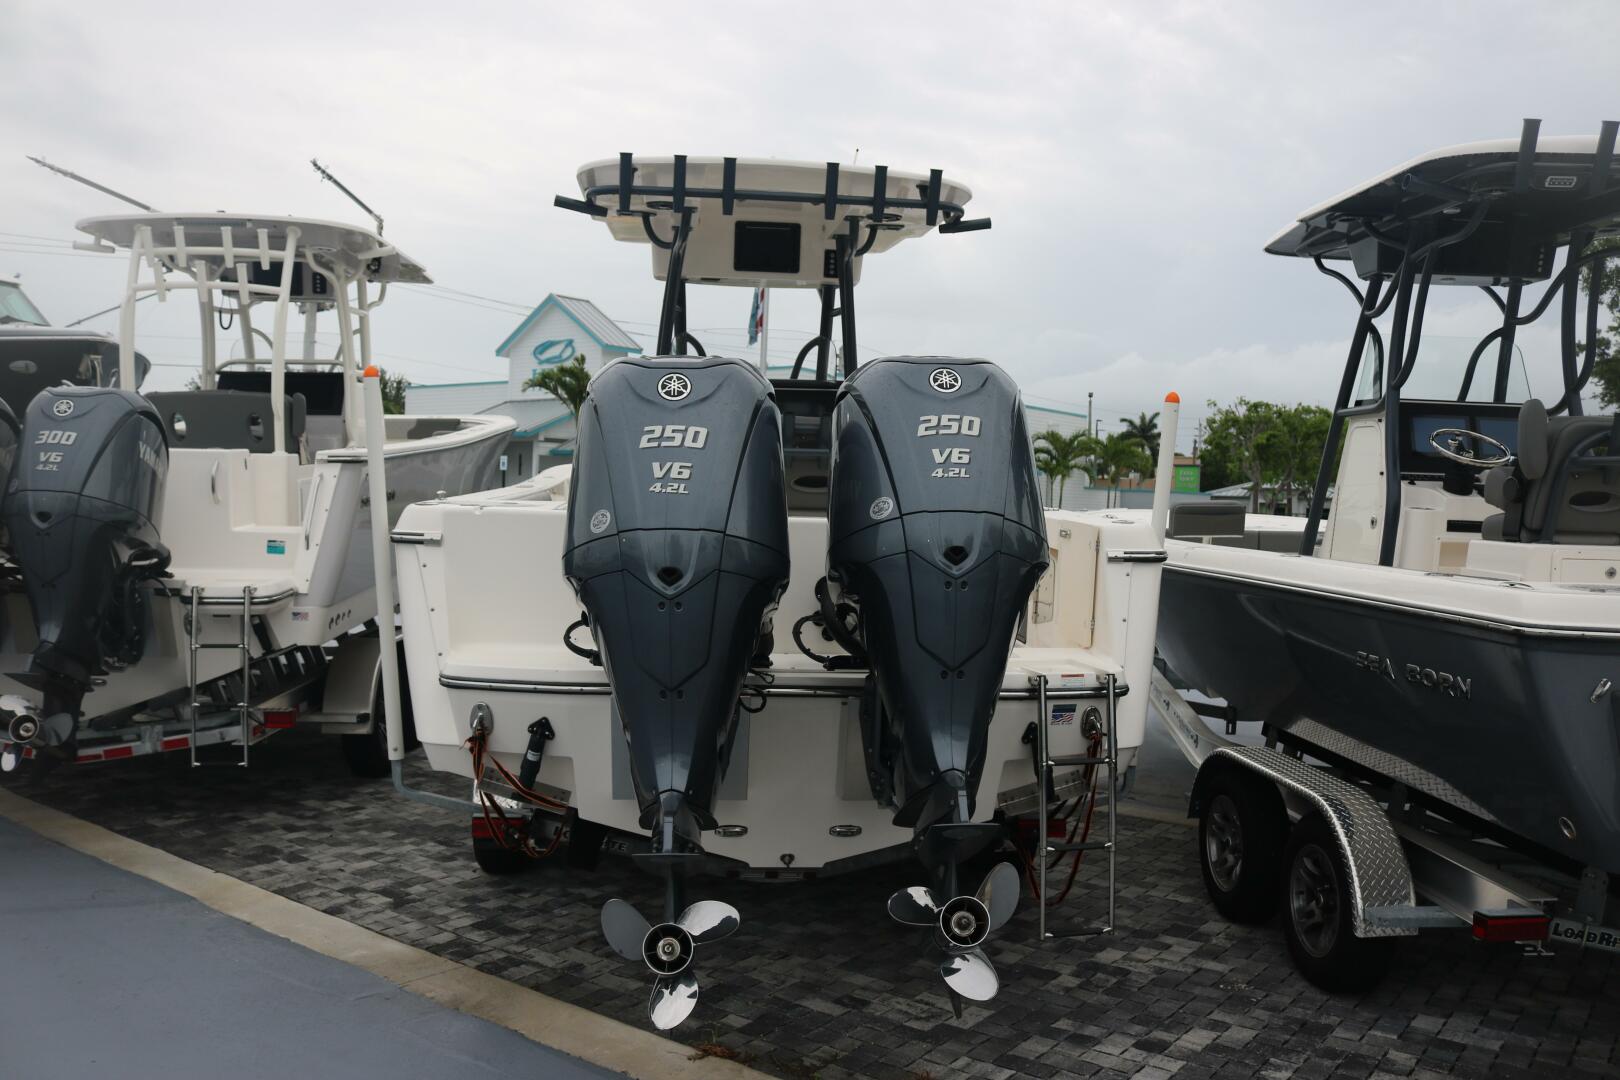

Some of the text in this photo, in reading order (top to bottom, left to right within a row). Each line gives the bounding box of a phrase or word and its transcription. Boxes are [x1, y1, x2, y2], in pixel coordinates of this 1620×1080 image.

[917, 414, 982, 437] 250
[34, 430, 78, 445] 300
[639, 424, 709, 450] 250
[39, 451, 65, 463] V6
[931, 447, 972, 465] V6
[34, 464, 60, 472] 4.2L
[652, 461, 694, 480] V6
[931, 467, 971, 479] 4.2L
[648, 482, 690, 494] 4.2L
[1406, 663, 1471, 700] BORN
